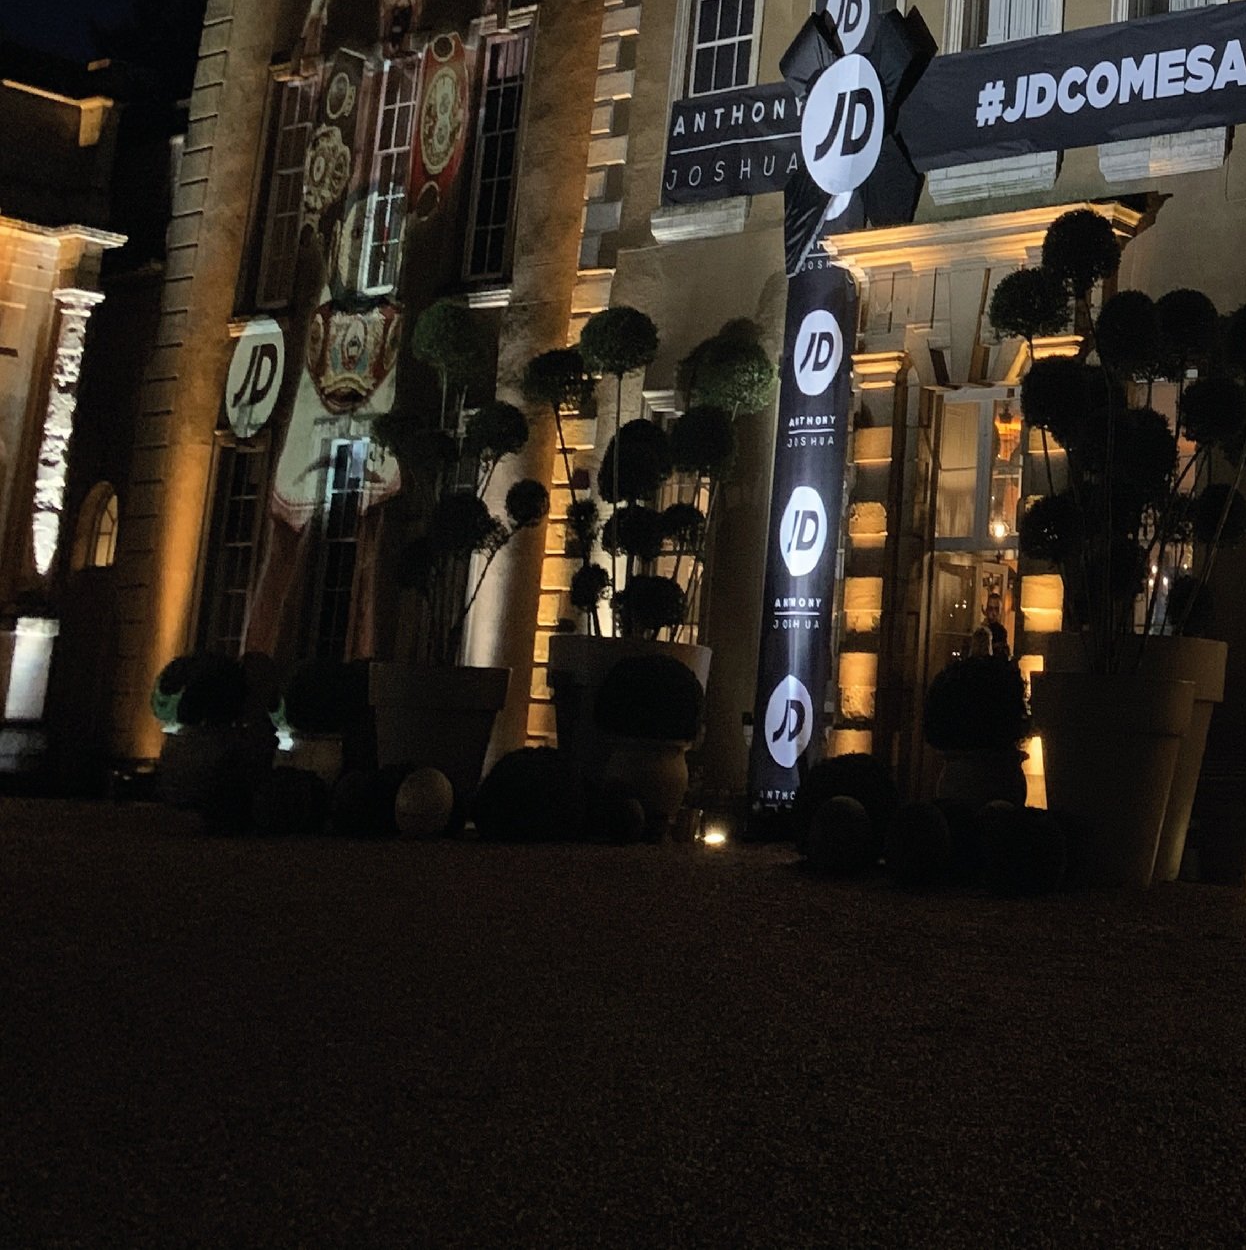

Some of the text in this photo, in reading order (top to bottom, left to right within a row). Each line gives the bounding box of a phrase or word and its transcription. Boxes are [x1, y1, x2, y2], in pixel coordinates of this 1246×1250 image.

[672, 97, 804, 137] ANTHONY
[813, 87, 875, 162] JD
[666, 152, 799, 191] JOSHUA
[800, 260, 832, 272] JOSH
[799, 331, 834, 374] JD
[231, 343, 278, 409] JD
[786, 509, 820, 553] JD
[772, 699, 806, 743] JD
